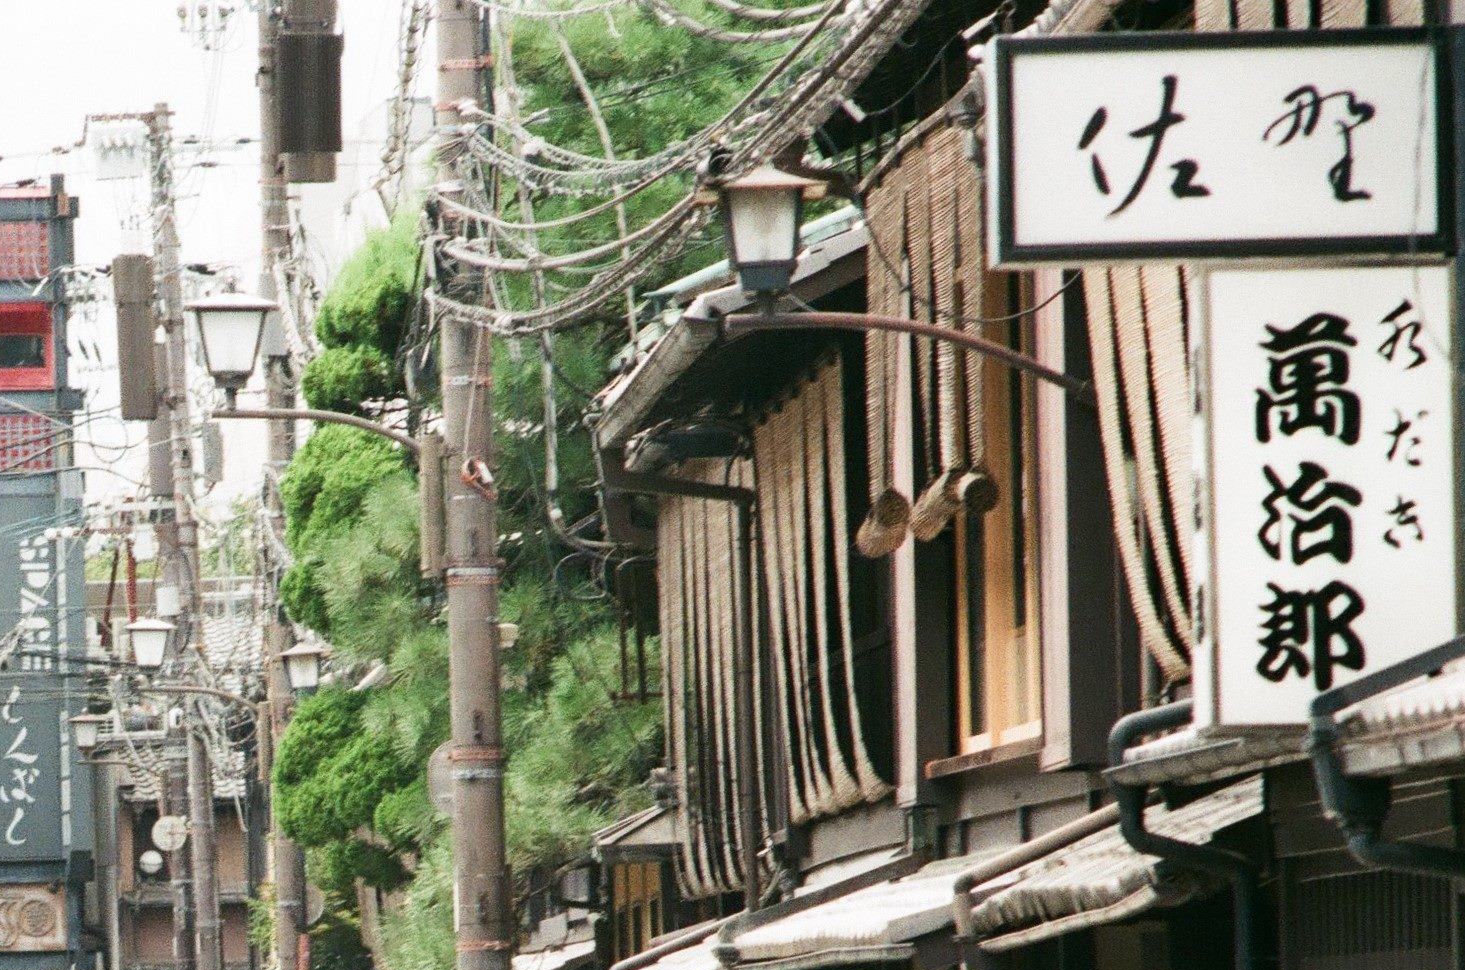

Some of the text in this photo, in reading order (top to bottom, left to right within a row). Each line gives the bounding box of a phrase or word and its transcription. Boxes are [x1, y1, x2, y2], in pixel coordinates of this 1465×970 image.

[1254, 312, 1366, 693] 萬治郎
[0, 685, 40, 847] しんばし
